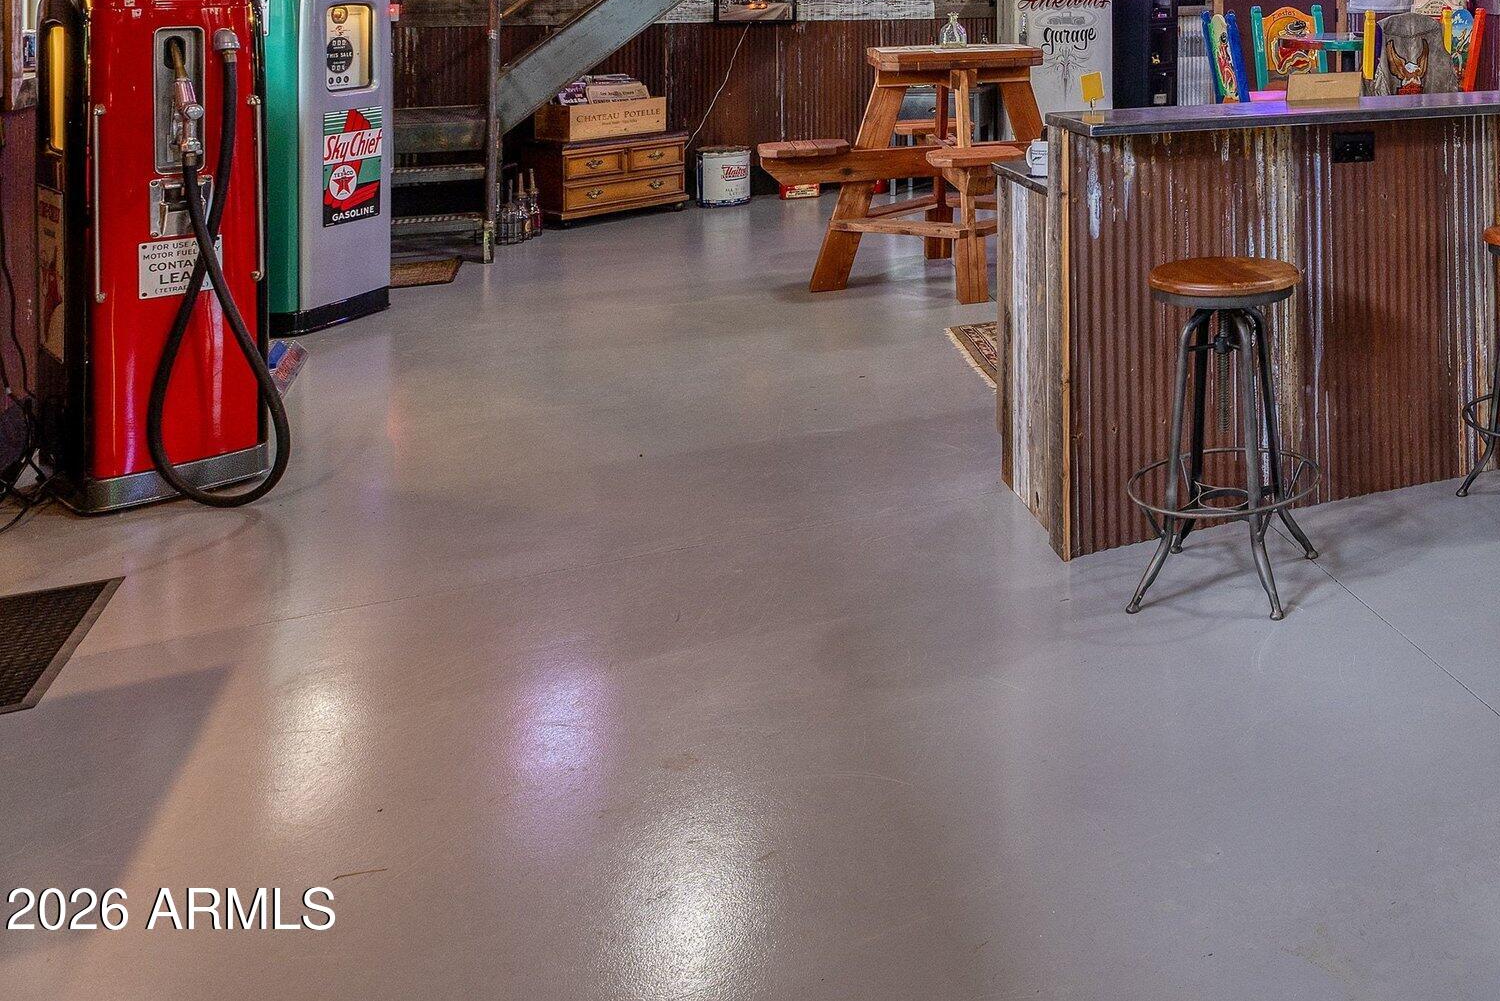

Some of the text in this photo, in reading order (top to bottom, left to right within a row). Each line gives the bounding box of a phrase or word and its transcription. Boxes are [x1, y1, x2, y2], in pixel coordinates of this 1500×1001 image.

[1041, 27, 1097, 55] garage
[576, 112, 620, 123] CHATEAU
[624, 108, 661, 118] POTELLE
[323, 128, 382, 163] Sky Chief
[332, 206, 375, 221] GASOLINE
[152, 243, 169, 251] FOR
[172, 241, 189, 249] USE
[143, 248, 197, 260] MOTOR FUEL
[149, 259, 197, 273] CONTA
[160, 271, 192, 285] LEA
